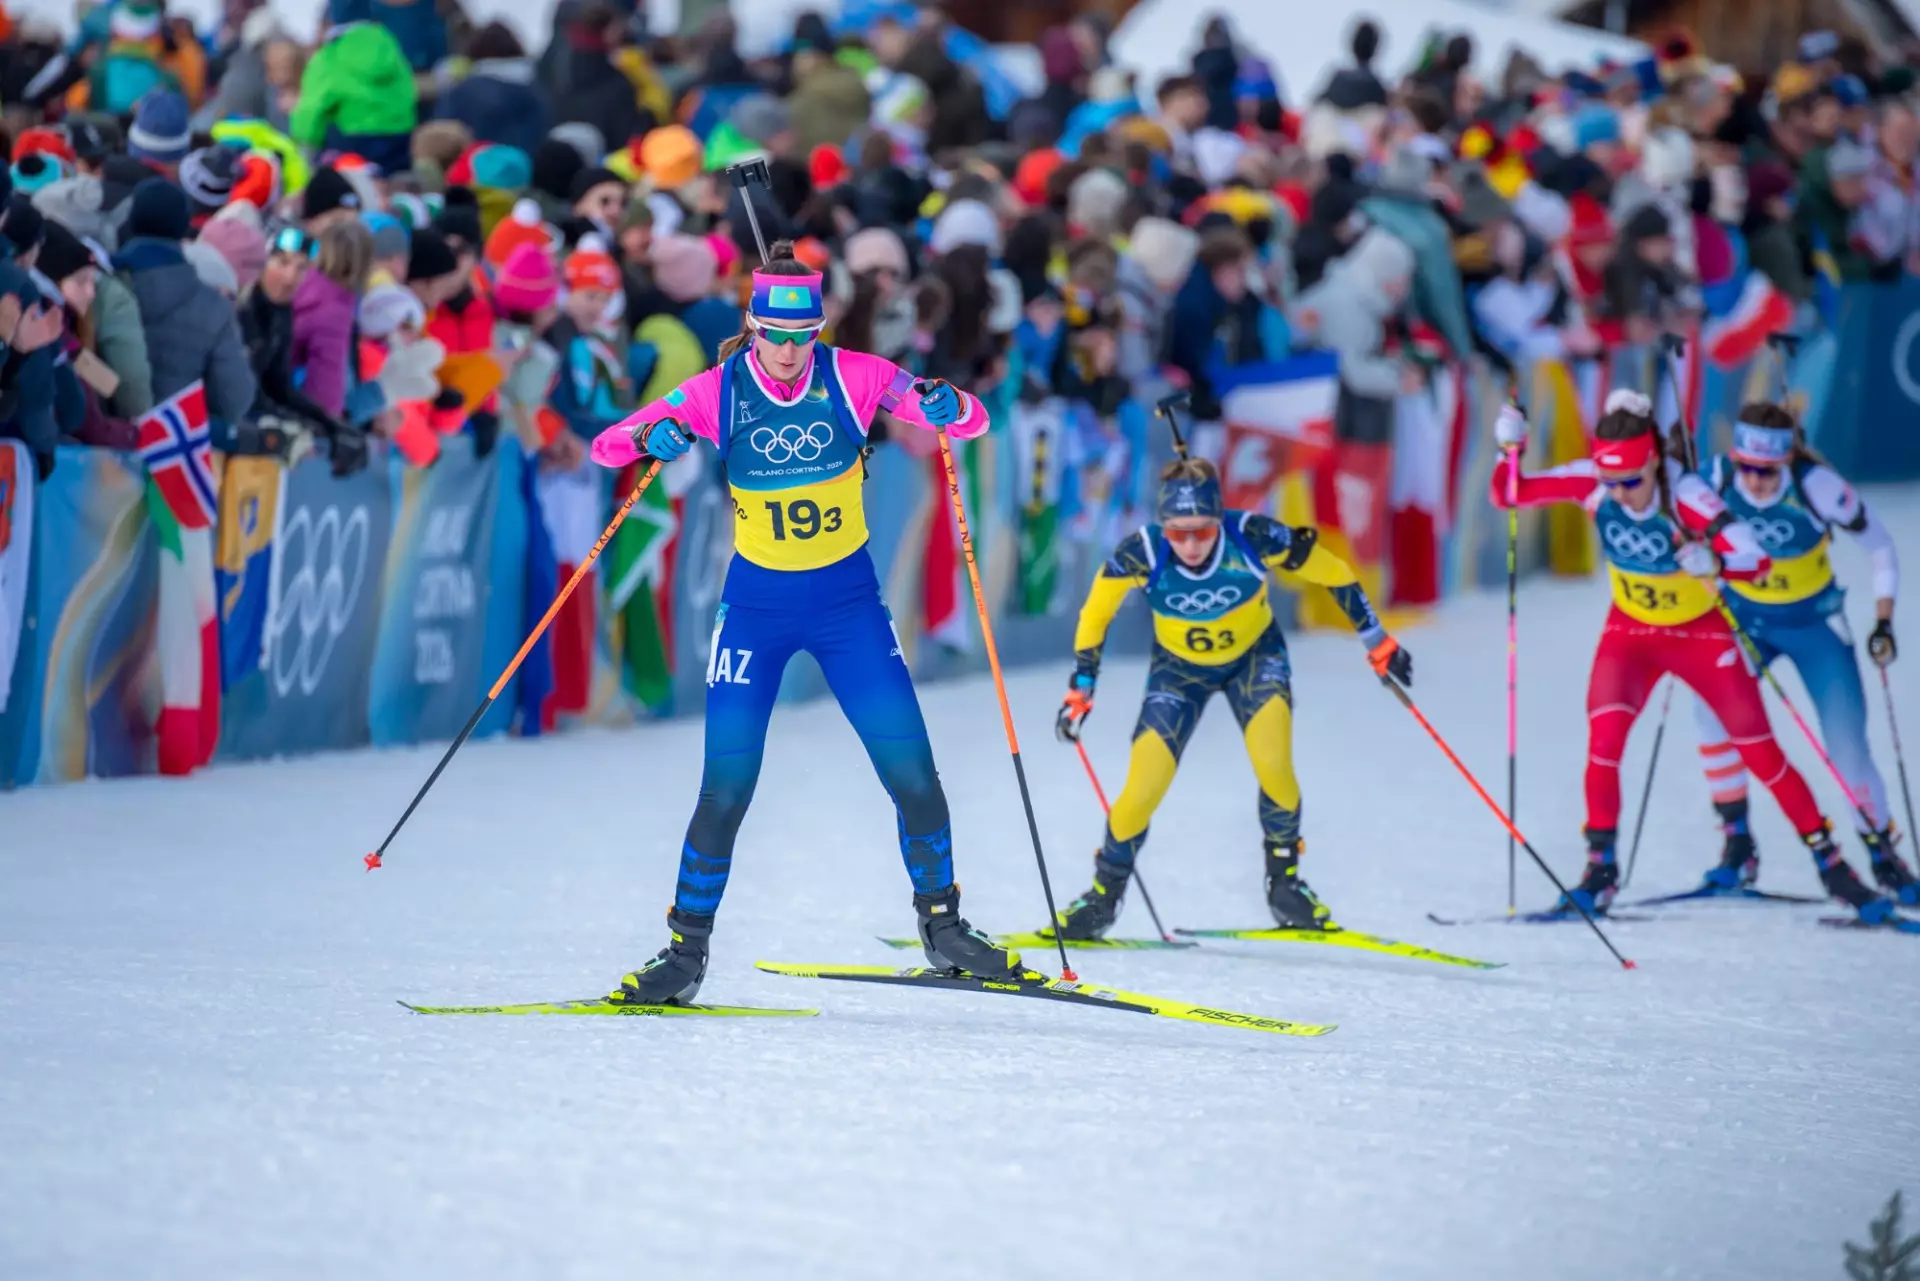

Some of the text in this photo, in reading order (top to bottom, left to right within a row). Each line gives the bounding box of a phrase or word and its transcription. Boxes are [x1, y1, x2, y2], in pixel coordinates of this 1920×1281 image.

[747, 460, 843, 477] MILANO CORTINA 2026
[982, 981, 1021, 992] FISCHER
[616, 1006, 664, 1016] FISCHER
[1186, 1008, 1292, 1030] FISCHER
